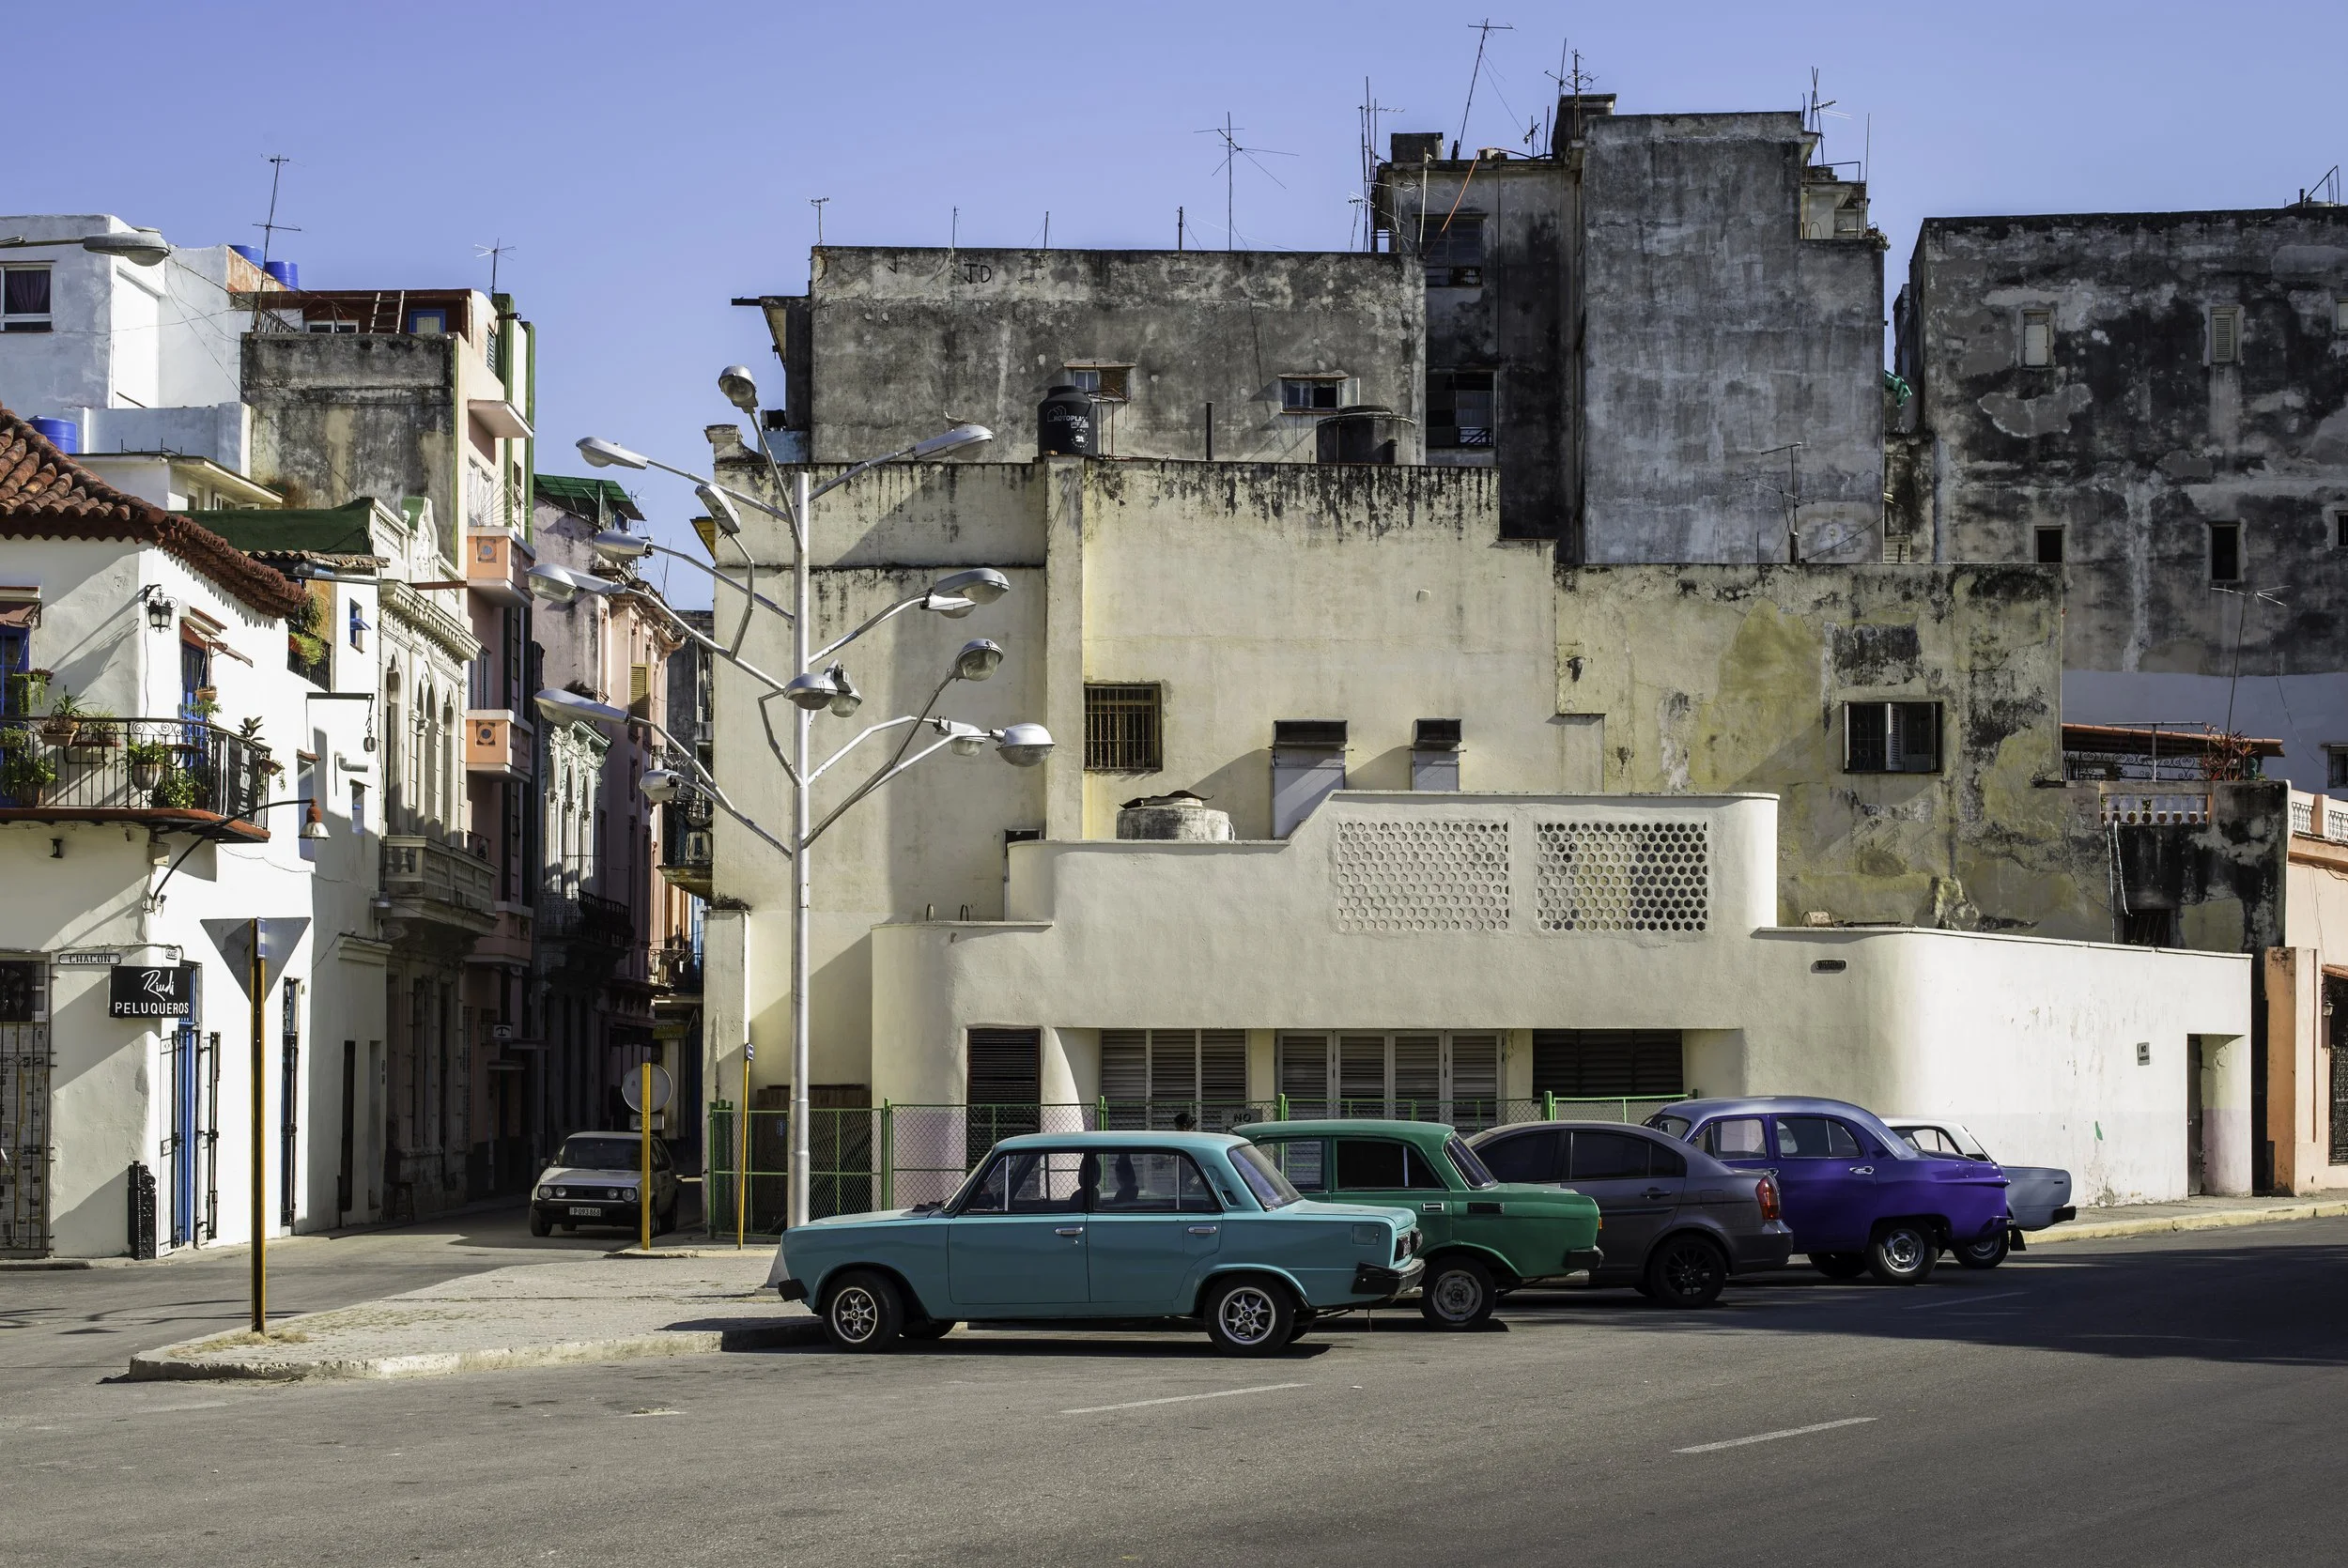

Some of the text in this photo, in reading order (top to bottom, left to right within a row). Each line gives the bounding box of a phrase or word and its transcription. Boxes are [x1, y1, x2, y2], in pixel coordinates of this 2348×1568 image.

[69, 955, 111, 963] CHACON
[115, 1002, 190, 1015] PELUQUEROS
[1233, 1113, 1252, 1123] NO
